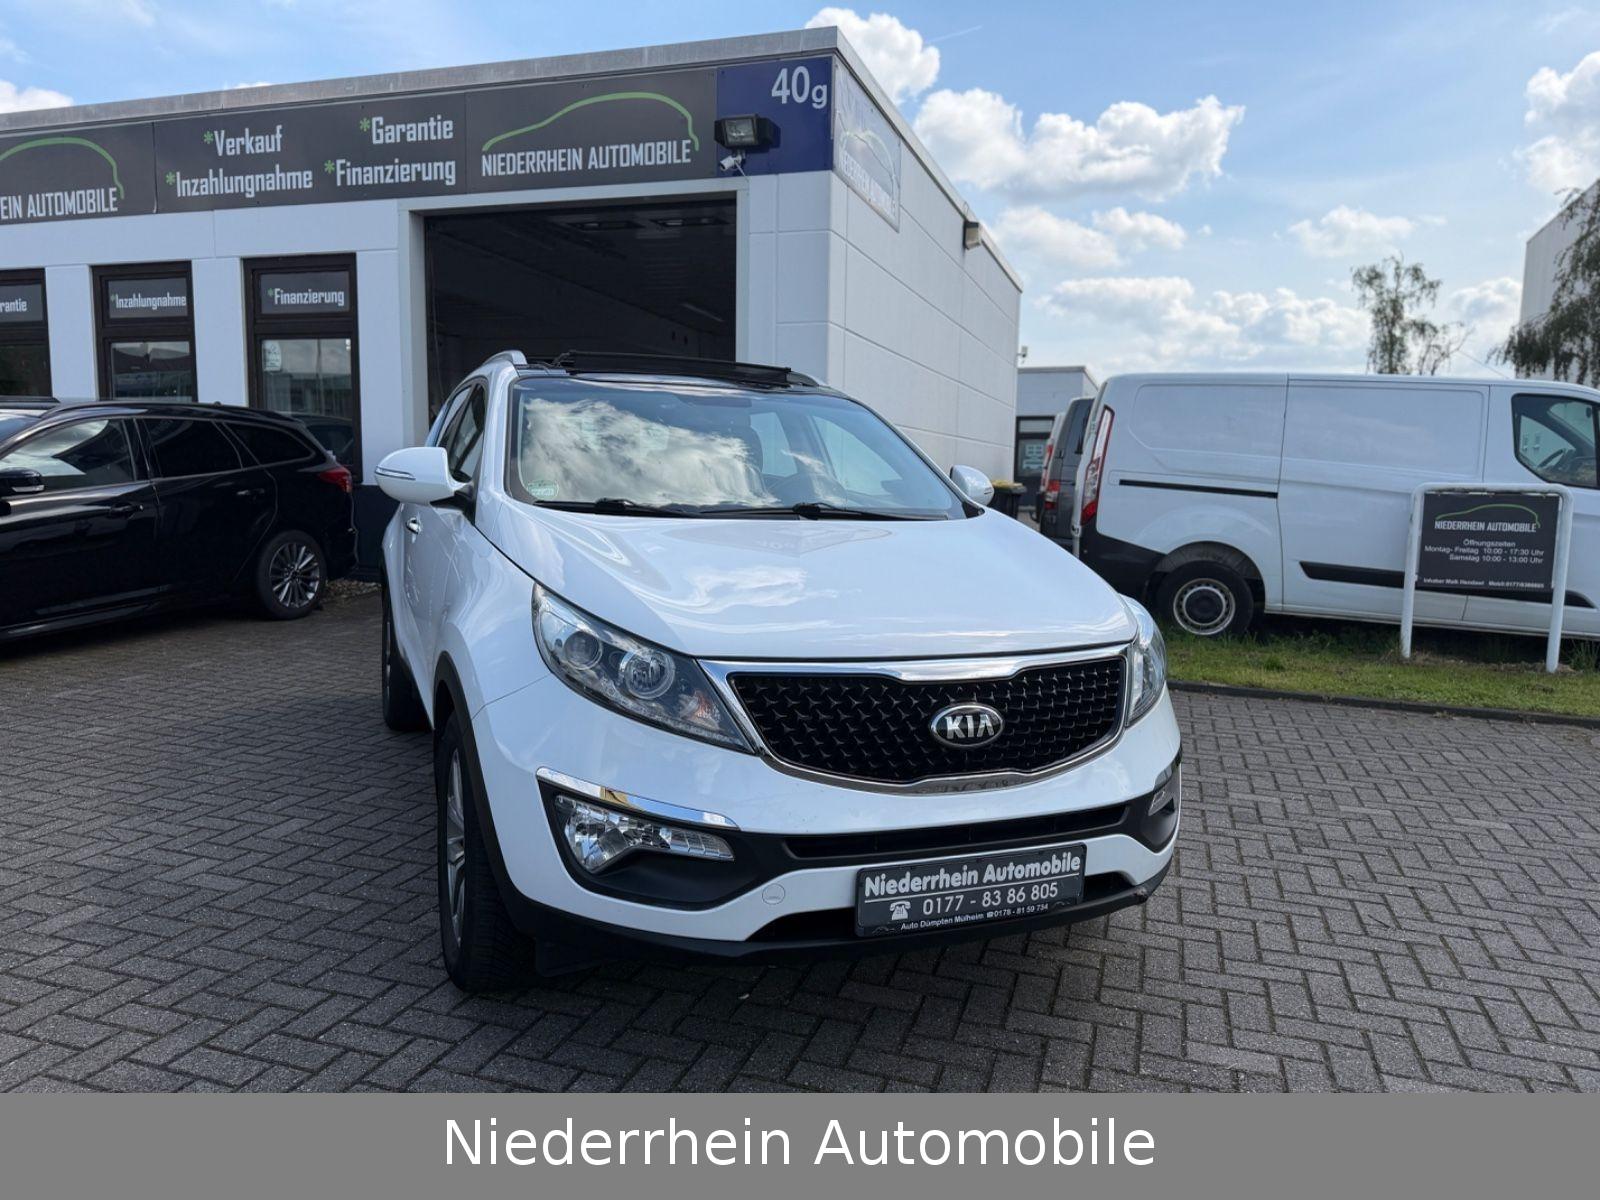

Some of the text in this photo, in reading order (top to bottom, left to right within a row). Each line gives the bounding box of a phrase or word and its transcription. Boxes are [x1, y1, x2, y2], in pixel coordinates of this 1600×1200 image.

[771, 65, 828, 109] 40g
[213, 124, 283, 157] Verkauf
[371, 114, 454, 145] Garantie
[335, 158, 457, 187] Finanzierung
[481, 139, 692, 177] NIEDERRHEIN AUTOMOBILE
[175, 164, 313, 199] Inzahlungnahme
[27, 187, 118, 218] AUTOMOBILE
[115, 292, 187, 311] Inzahlungnahme
[274, 287, 345, 307] Finanzierung
[1434, 520, 1537, 533] NIEDERRHEIN AUTOMOBILE
[1454, 547, 1479, 556] Freitag
[1530, 549, 1545, 557] Uhr
[1529, 556, 1544, 564] Uhr
[944, 713, 995, 740] KIA
[864, 851, 1082, 898] Niederrhein Automobile
[922, 894, 965, 916] 0177
[982, 890, 1001, 908] 83
[1006, 887, 1027, 904] 86
[1030, 882, 1059, 901] 805
[900, 921, 919, 931] Auto
